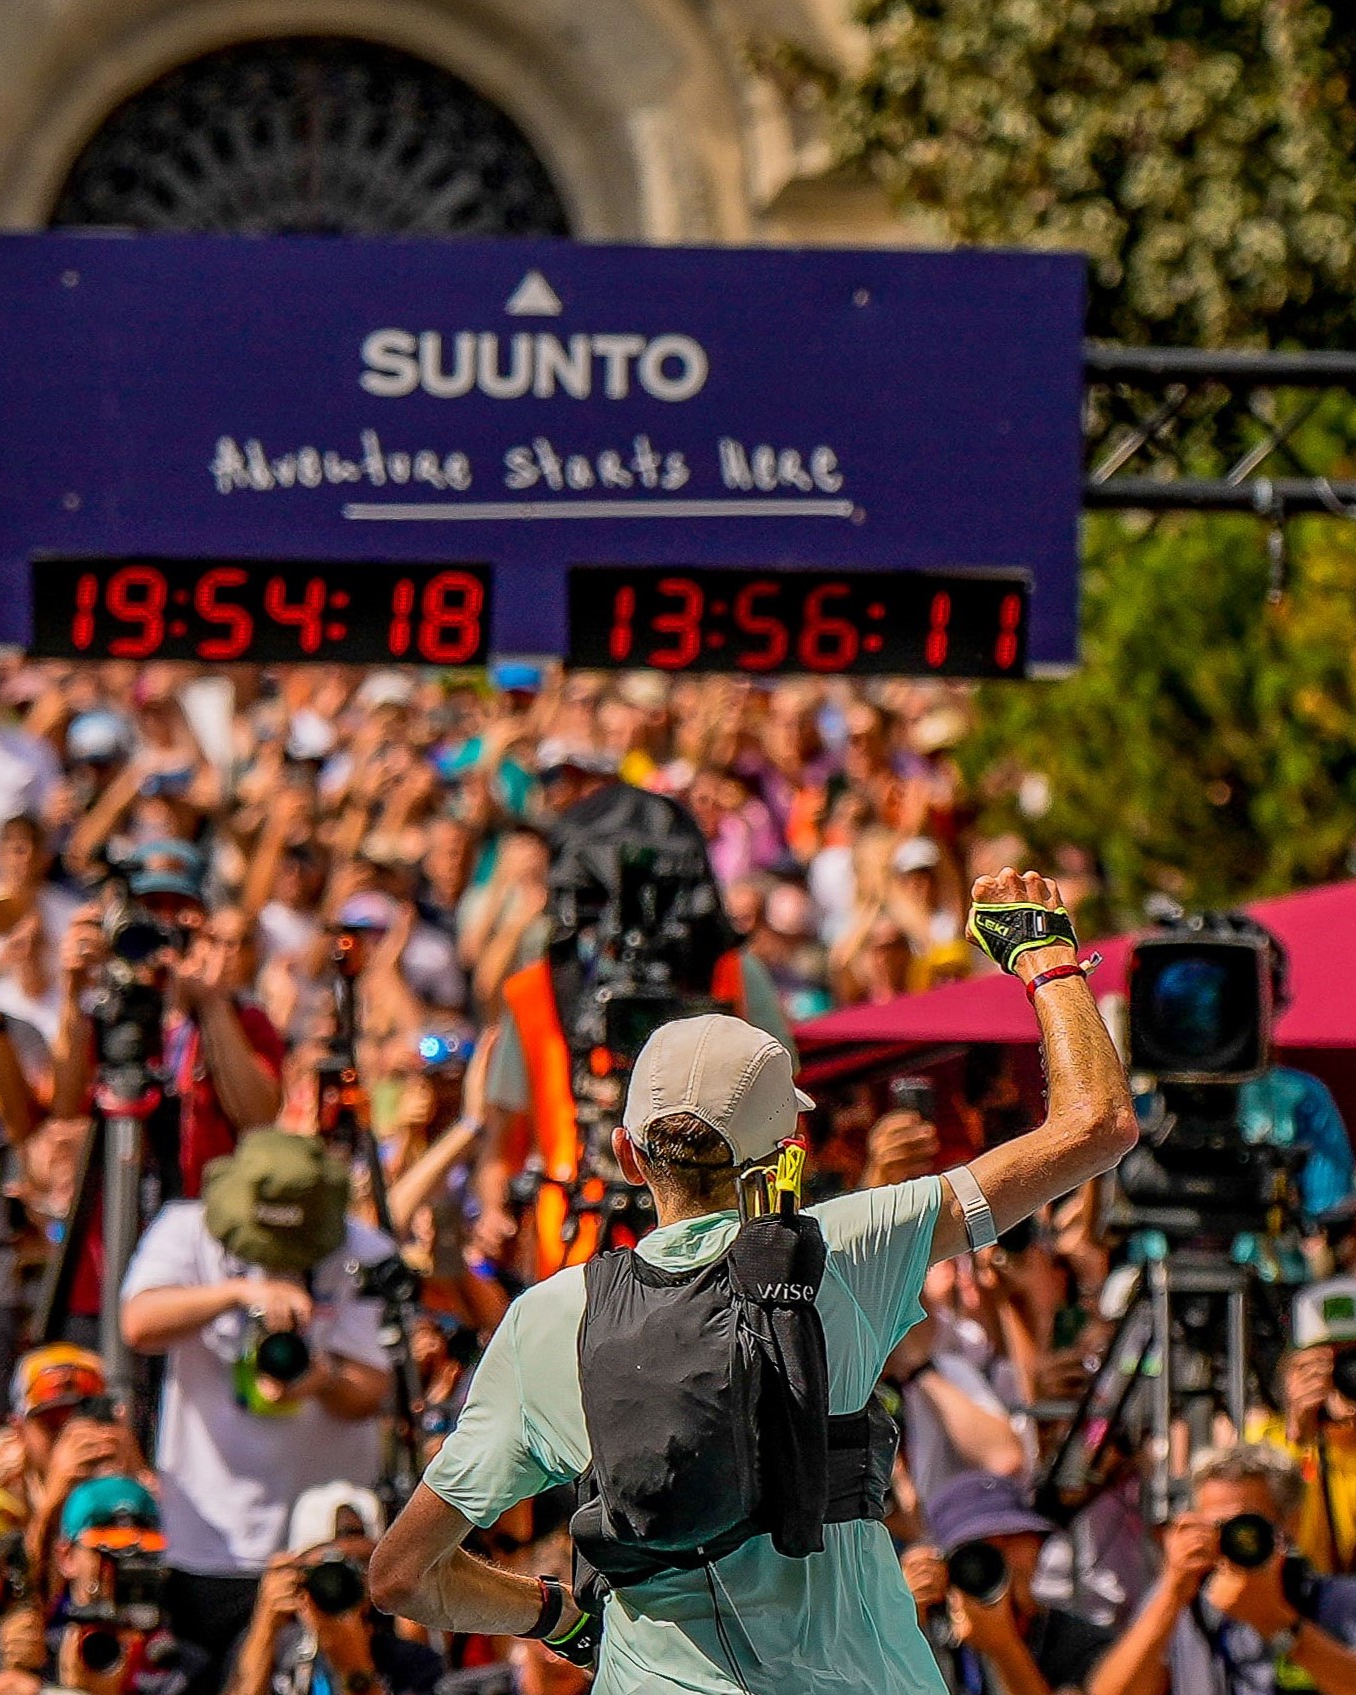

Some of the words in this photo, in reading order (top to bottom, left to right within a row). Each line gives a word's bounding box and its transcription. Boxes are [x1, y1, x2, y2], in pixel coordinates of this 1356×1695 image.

[358, 328, 710, 402] SUUNTO
[69, 565, 485, 665] 19:54:18
[976, 914, 1011, 937] LEKI
